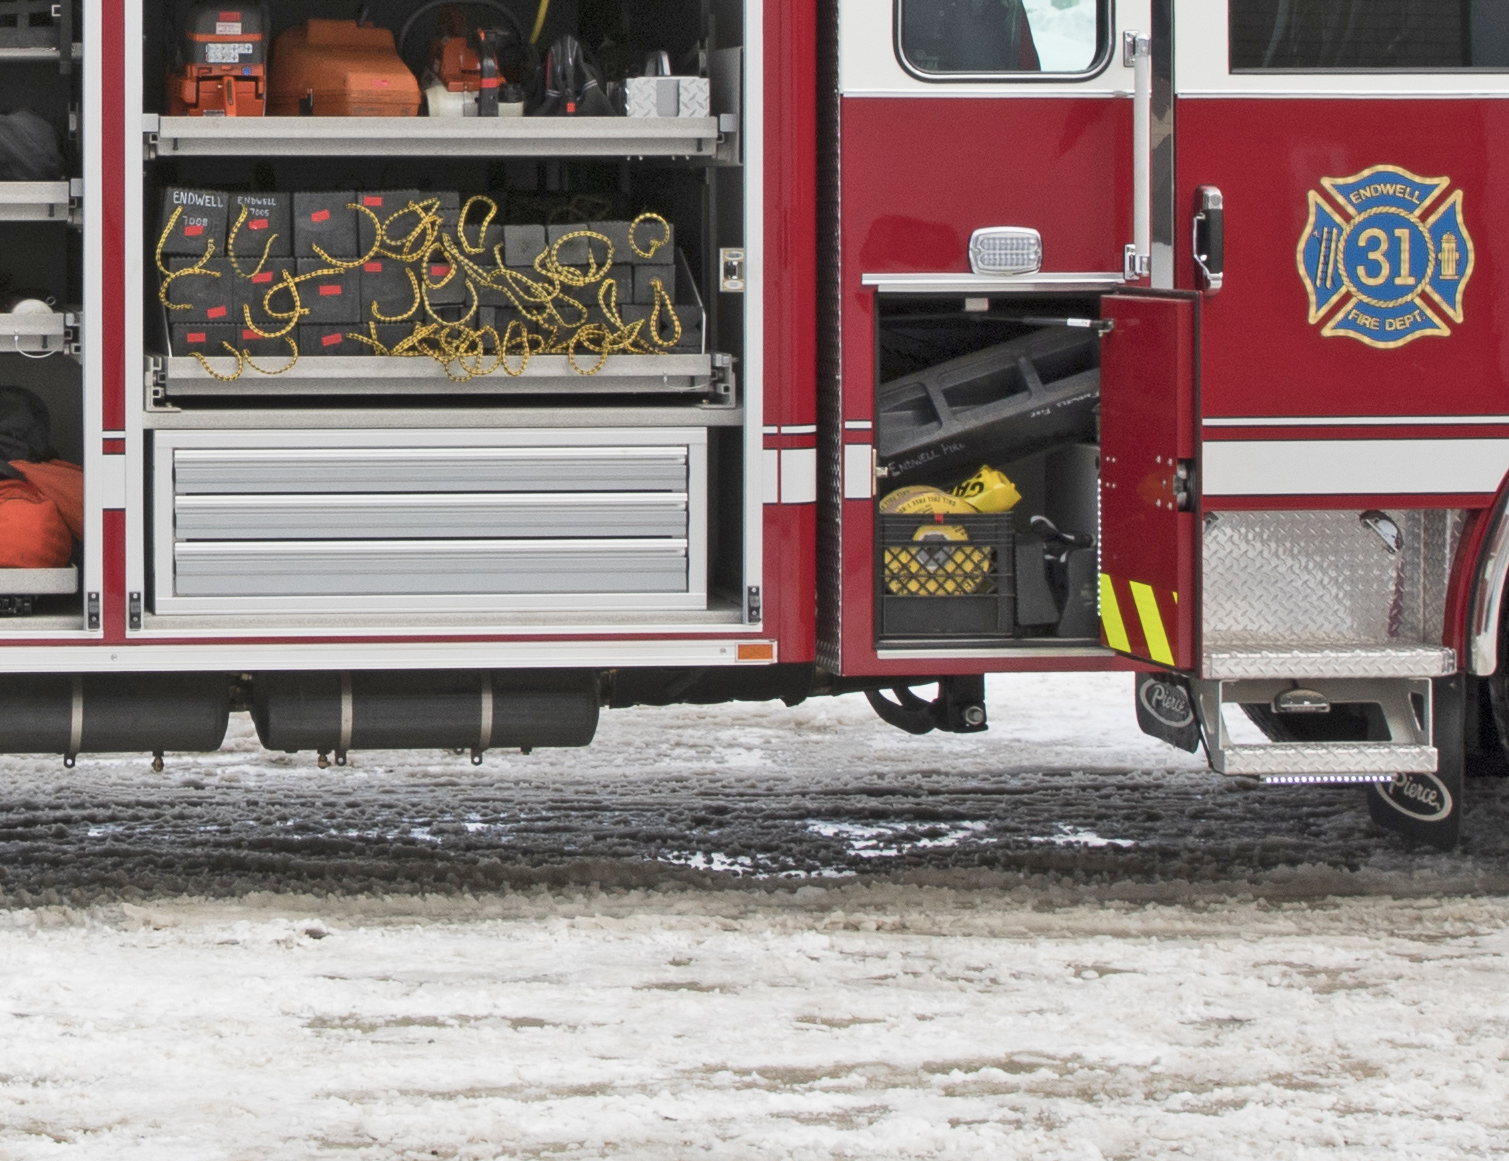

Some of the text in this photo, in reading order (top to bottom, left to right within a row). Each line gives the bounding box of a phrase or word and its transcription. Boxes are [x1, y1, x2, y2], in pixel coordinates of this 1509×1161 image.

[173, 191, 224, 208] ENDWELL
[237, 196, 277, 206] ENDWELL
[1349, 183, 1421, 205] ENDWELL
[1356, 228, 1416, 287] 31
[1347, 308, 1426, 331] FIRE DEPT.
[1151, 681, 1188, 712] Pierce
[1387, 773, 1440, 807] Pierce
